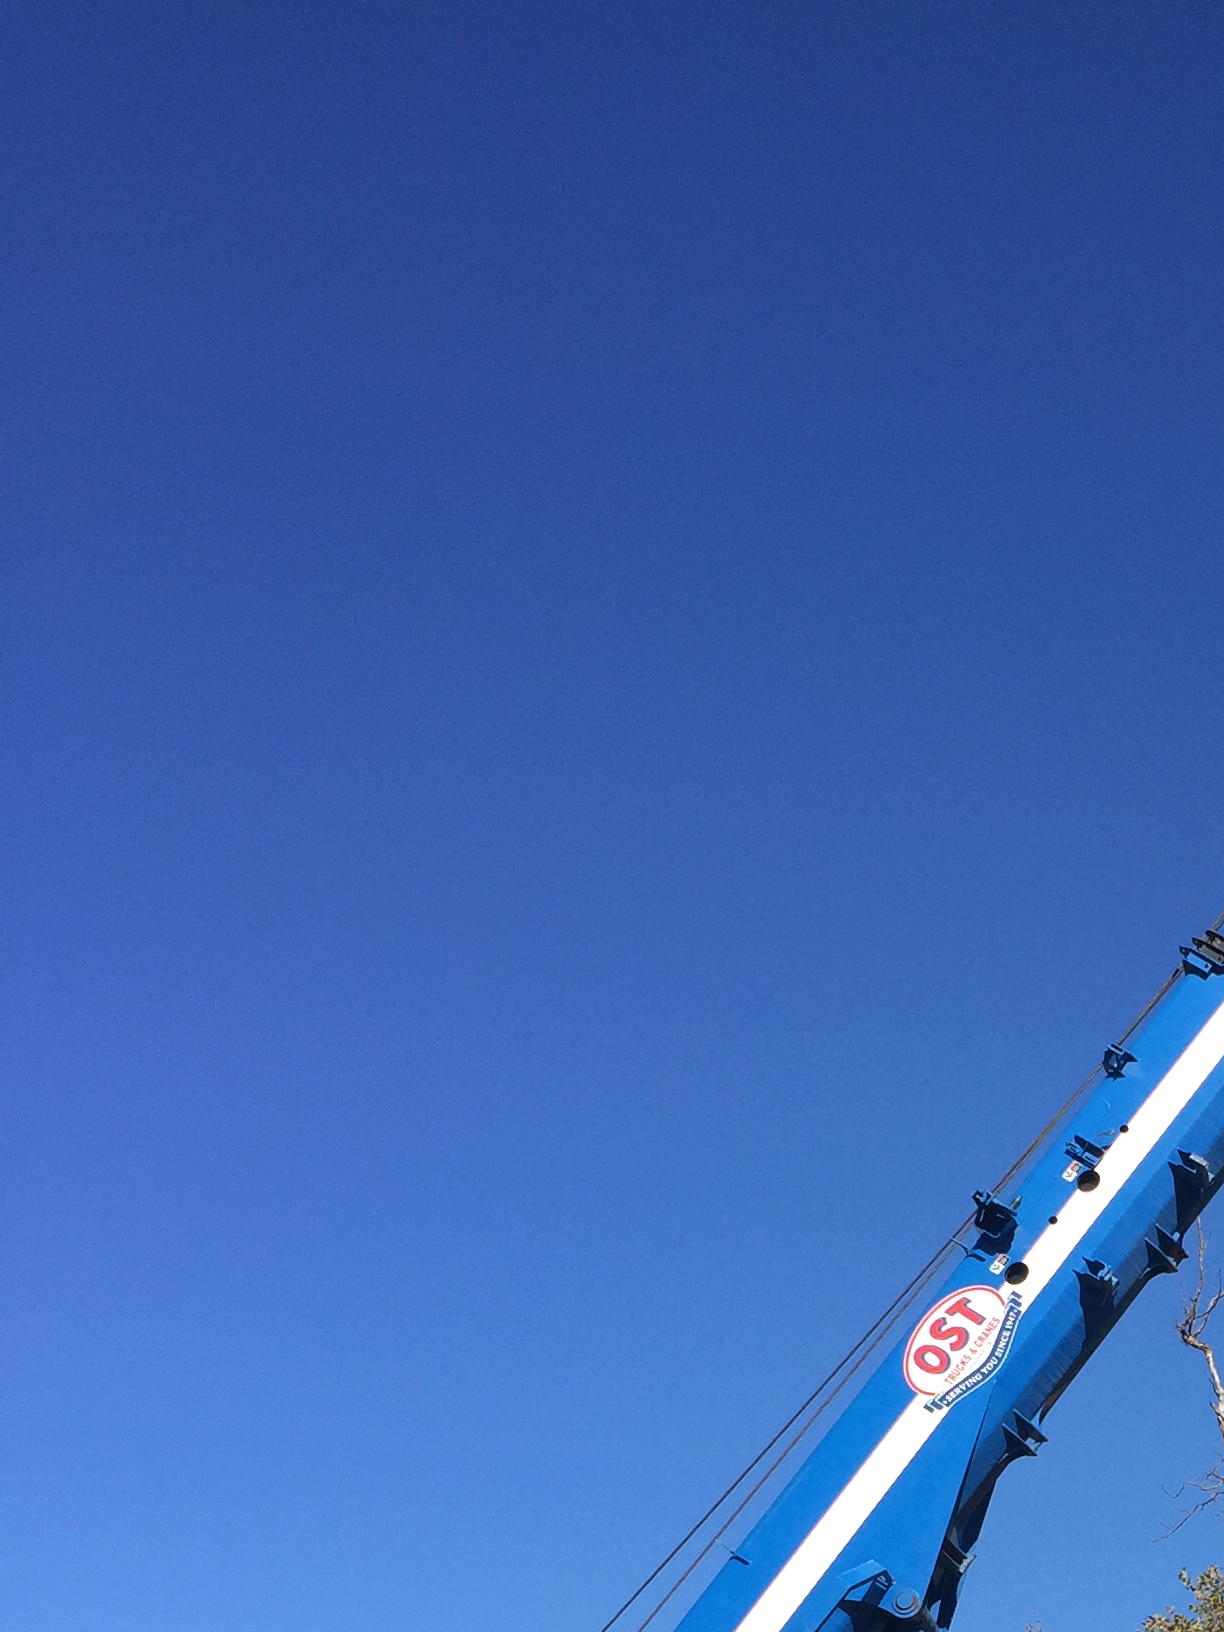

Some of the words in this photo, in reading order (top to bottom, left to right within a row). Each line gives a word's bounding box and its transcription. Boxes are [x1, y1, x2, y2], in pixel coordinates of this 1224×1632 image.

[913, 1296, 987, 1375] OST
[944, 1354, 972, 1385] TRUCKS
[973, 1316, 1001, 1348] CRANES
[945, 1373, 983, 1402] SERVING
[980, 1357, 999, 1376] YOU
[994, 1331, 1010, 1358] SINCE
